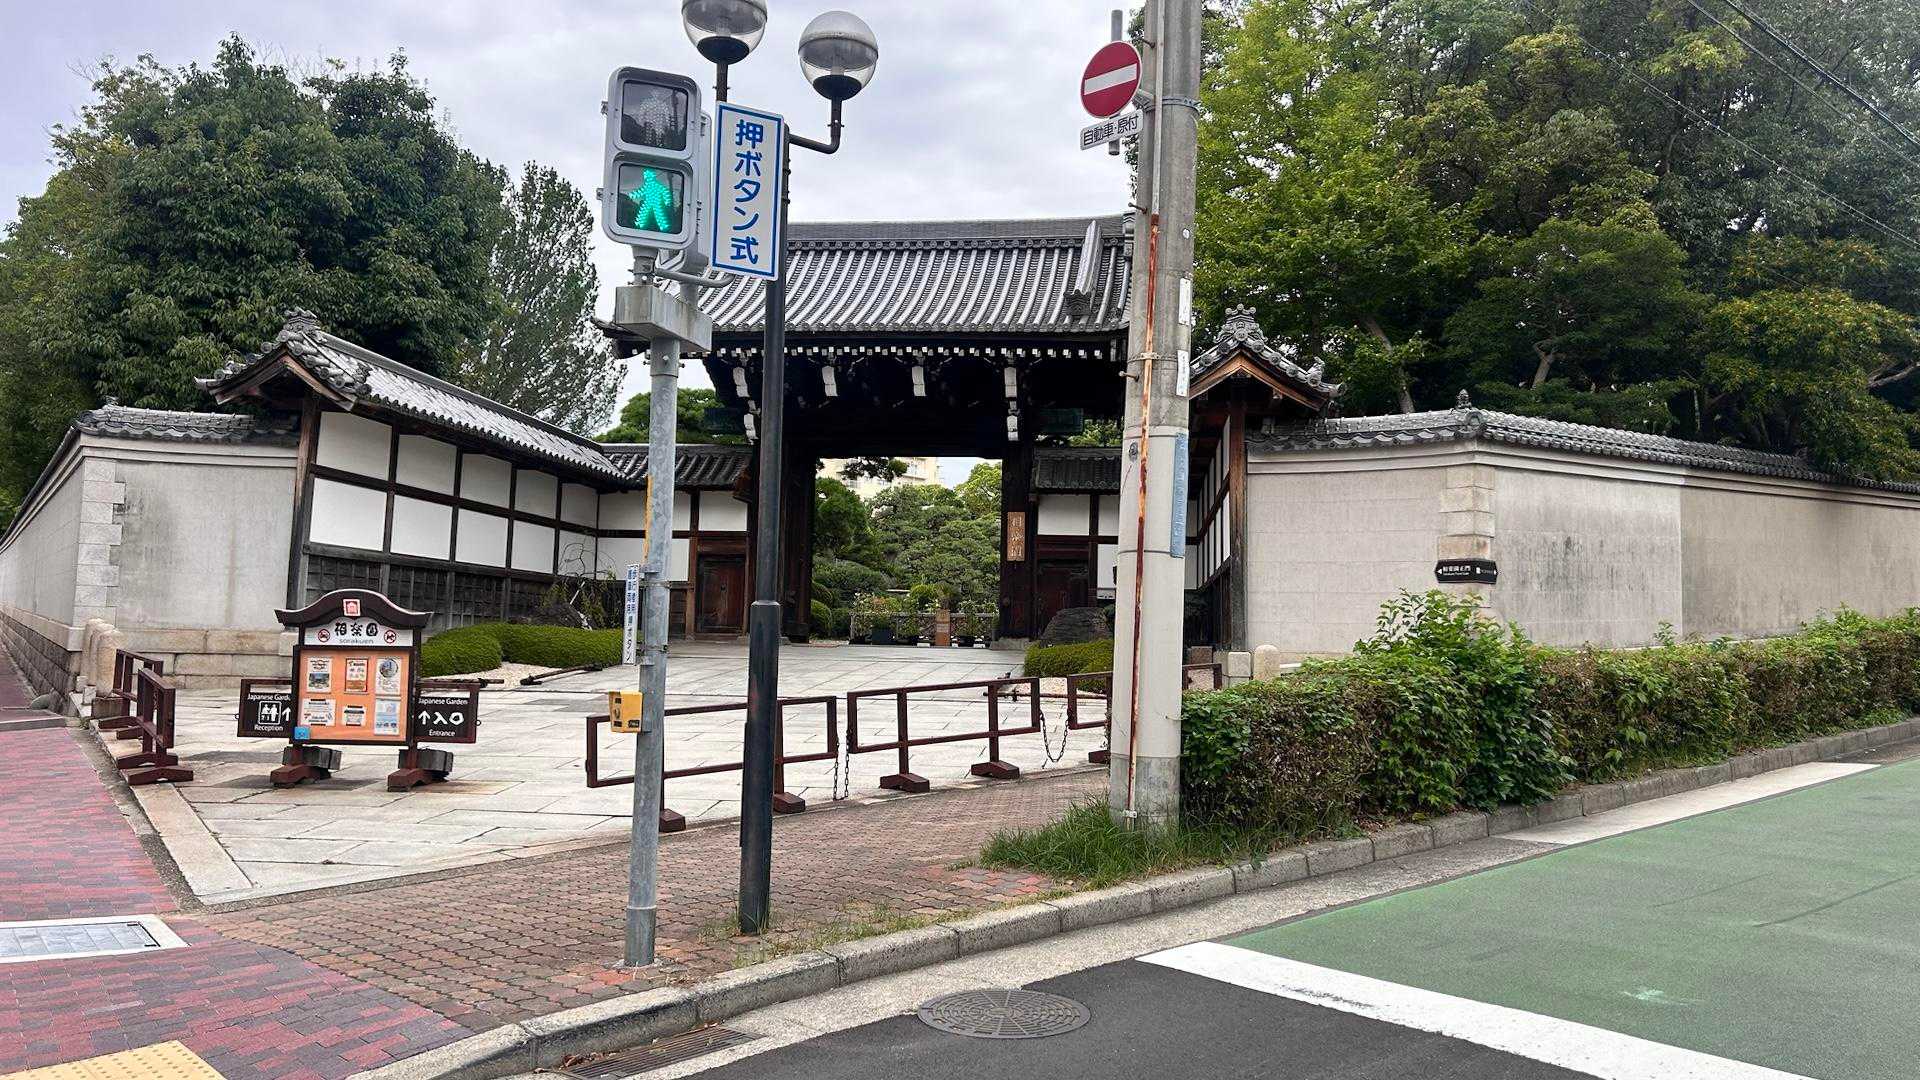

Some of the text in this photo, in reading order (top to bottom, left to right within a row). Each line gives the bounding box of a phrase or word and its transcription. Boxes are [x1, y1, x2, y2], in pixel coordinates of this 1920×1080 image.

[1083, 115, 1139, 146] 自動車・原付
[729, 119, 764, 265] 押ボタン式
[334, 622, 379, 637] 相楽園
[247, 693, 273, 701] Japanese
[433, 711, 465, 726] 入口
